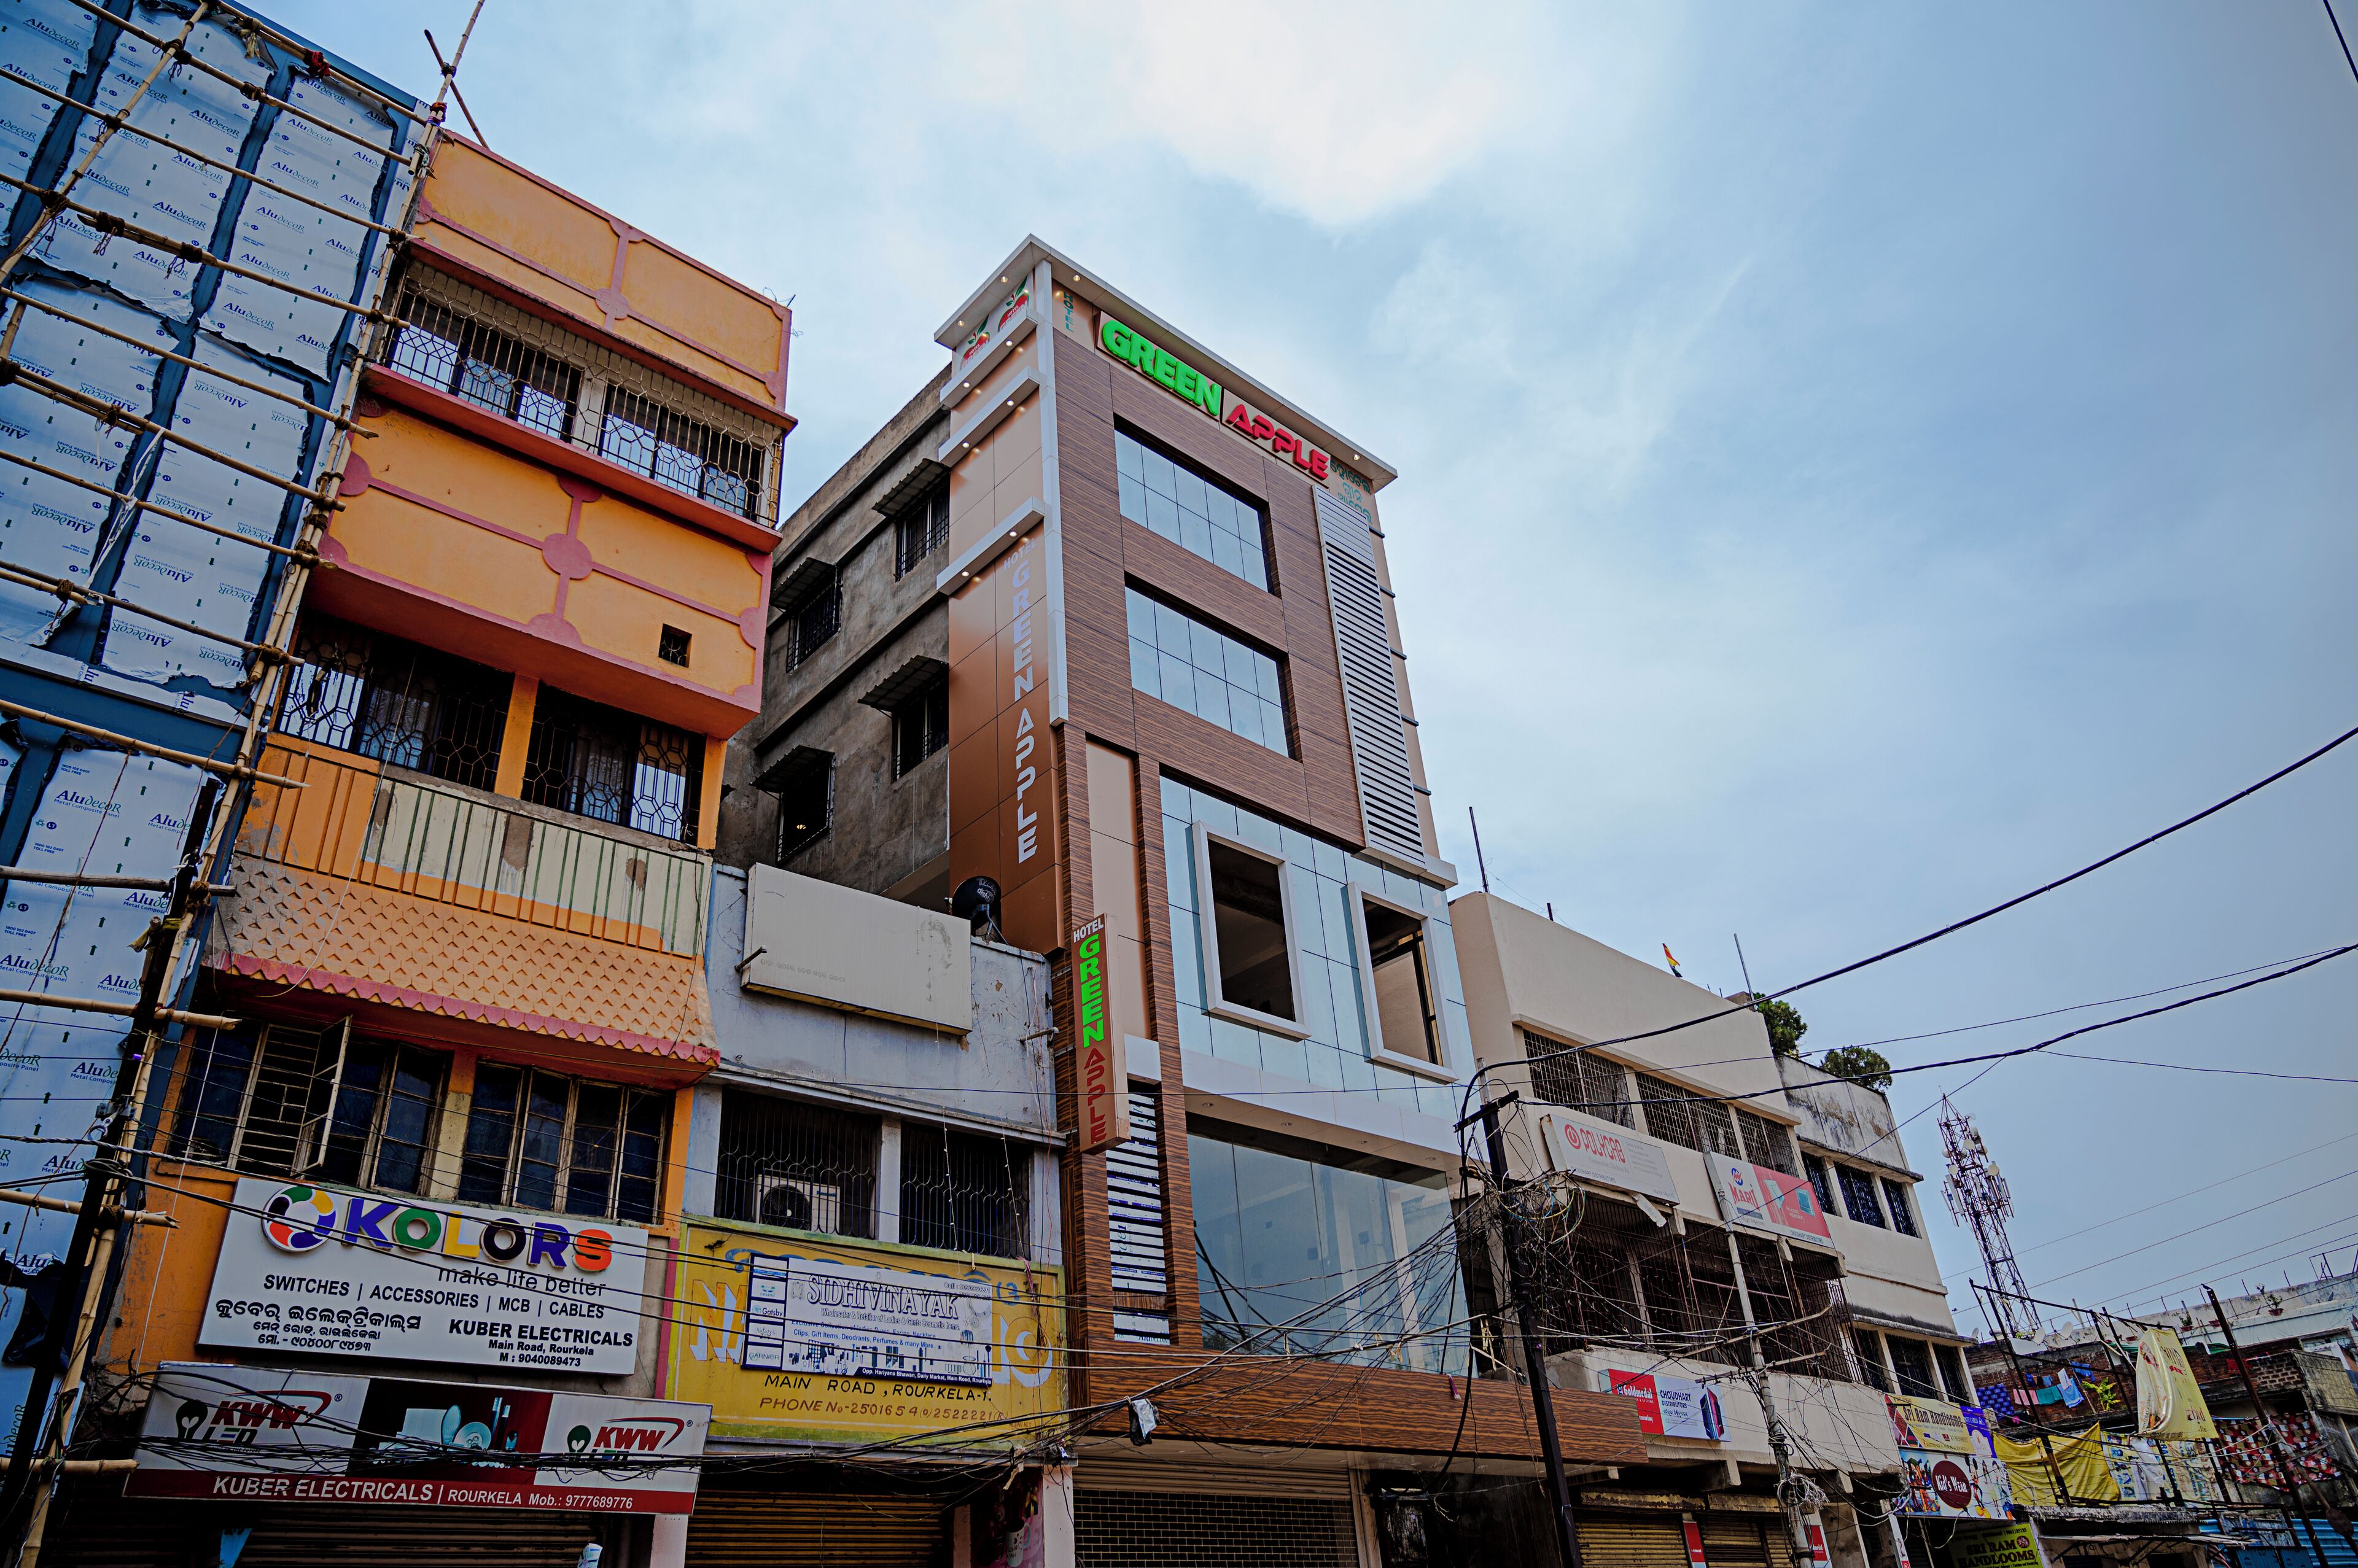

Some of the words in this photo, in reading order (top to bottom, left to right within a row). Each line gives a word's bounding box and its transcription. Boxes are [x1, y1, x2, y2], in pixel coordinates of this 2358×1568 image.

[1007, 305, 1019, 318] HOTEL
[1063, 291, 1074, 333] HOTEL
[969, 343, 981, 356] HOTEL
[1102, 320, 1222, 416] GREEN
[1227, 403, 1329, 481] APPLE
[1003, 537, 1036, 572] HOTEL
[1013, 559, 1033, 702] GREEN
[1016, 708, 1038, 864] APPLE
[72, 804, 103, 814] Composite
[1073, 917, 1104, 943] HOTEL
[1078, 933, 1106, 1048] GREEN
[1084, 1047, 1107, 1144] APPLE
[1579, 1127, 1626, 1163] POLYCAB
[341, 1198, 613, 1272] KOLORS
[438, 1267, 499, 1286] make
[507, 1268, 537, 1289] life
[545, 1274, 606, 1296] better
[263, 1275, 349, 1296] SWITCHES
[370, 1284, 479, 1308] ACCESSORIES
[499, 1297, 530, 1312] MCB
[550, 1302, 604, 1319] CABLES
[807, 1275, 959, 1319] SIDHIVINAYAK
[762, 1307, 783, 1317] Gatsby
[821, 1308, 850, 1318] Wholesaler
[857, 1312, 877, 1322] Retailer
[884, 1316, 901, 1324] Ladies
[922, 1321, 945, 1329] Cosmetic
[449, 1319, 512, 1338] KUBER
[518, 1325, 633, 1346] ELECTRICALS
[823, 1332, 840, 1340] Items,
[841, 1333, 871, 1343] Deodrants,
[873, 1337, 898, 1346] Perfumes
[488, 1340, 513, 1350] Main
[517, 1341, 545, 1353] Road,
[550, 1344, 594, 1356] Rourkela
[499, 1353, 510, 1362] M
[519, 1354, 581, 1367] 9040089473
[765, 1375, 811, 1389] MAIN
[827, 1380, 875, 1394] ROAD
[897, 1370, 916, 1379] Bhawan,
[1623, 1385, 1653, 1399] Goldmedal
[1660, 1390, 1691, 1402] CHOUDHARY
[210, 1400, 306, 1429] KWW
[760, 1397, 823, 1411] PHONE
[1903, 1407, 1913, 1421] Sri
[1915, 1408, 1930, 1423] Ram
[1930, 1411, 1964, 1428] Handlooms
[593, 1426, 666, 1451] KWW
[212, 1476, 289, 1496] KUBER
[295, 1480, 433, 1502] ELECTRICALS
[448, 1489, 521, 1505] ROURKELA
[528, 1494, 562, 1507] Mob.:
[565, 1495, 633, 1510] 9777689776
[1936, 1475, 1951, 1491] Kid's
[1957, 1550, 2035, 1568] HANDLOOMS
[1966, 1543, 1986, 1555] SRI
[1987, 1540, 2017, 1552] RAM
